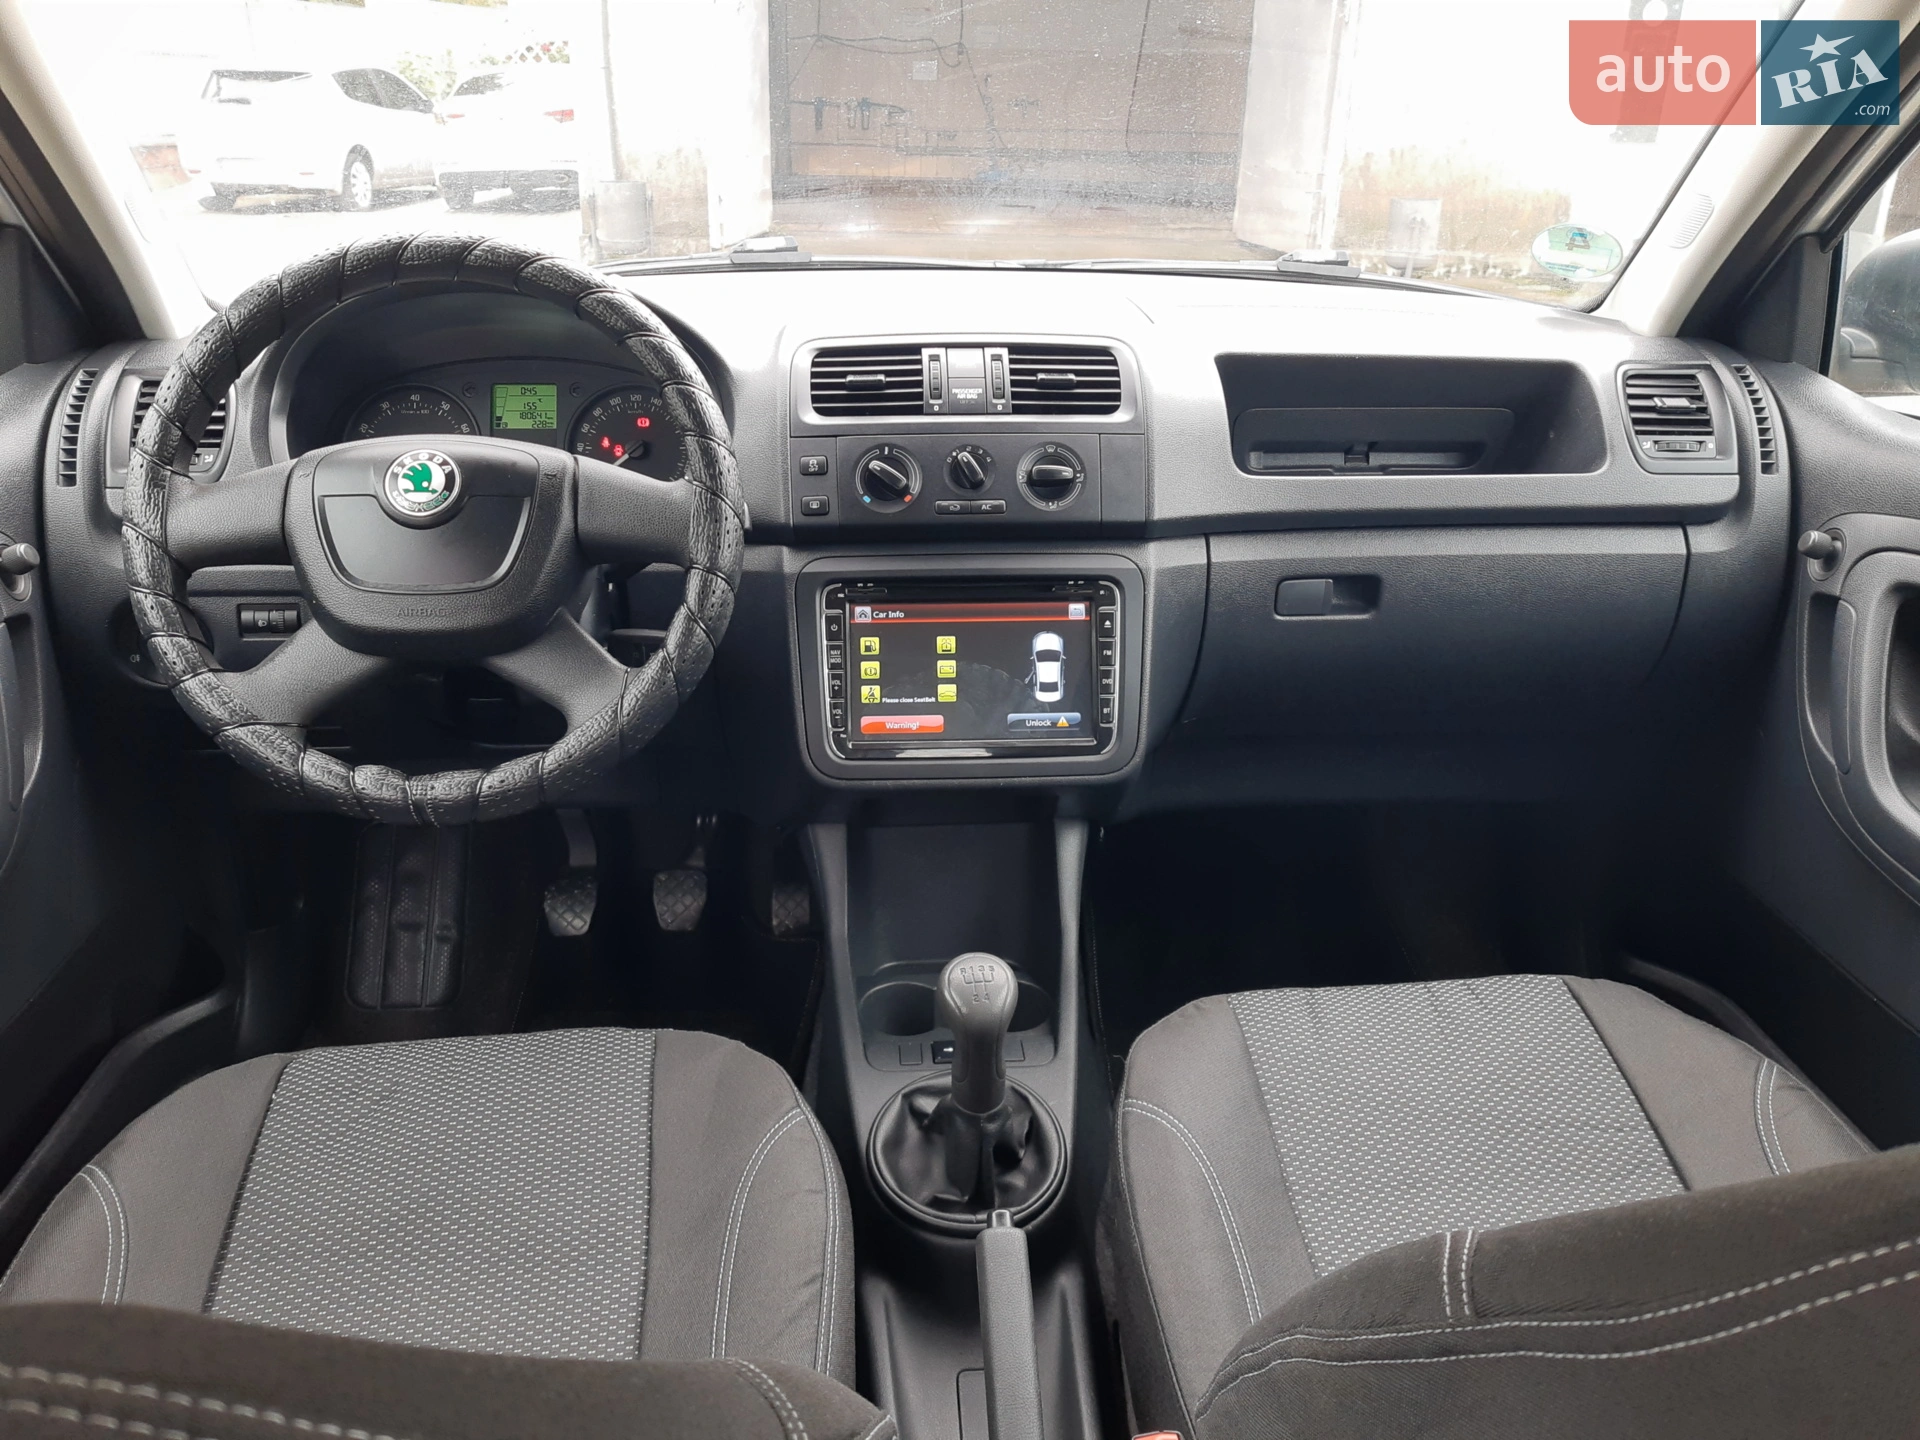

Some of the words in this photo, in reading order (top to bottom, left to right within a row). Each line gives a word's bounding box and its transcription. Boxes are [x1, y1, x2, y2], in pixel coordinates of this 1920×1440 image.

[380, 401, 390, 411] 30
[440, 401, 451, 411] 50
[609, 397, 622, 406] 100
[650, 397, 663, 406] 140
[592, 407, 603, 417] 80
[360, 423, 369, 433] 20
[461, 423, 471, 433] 60
[581, 423, 591, 433] 60
[576, 442, 585, 452] 40
[397, 606, 448, 617] AIRBAG
[873, 610, 888, 618] Car
[888, 610, 905, 618] Info
[885, 721, 920, 730] Warning!
[1025, 719, 1052, 727] Unlock
